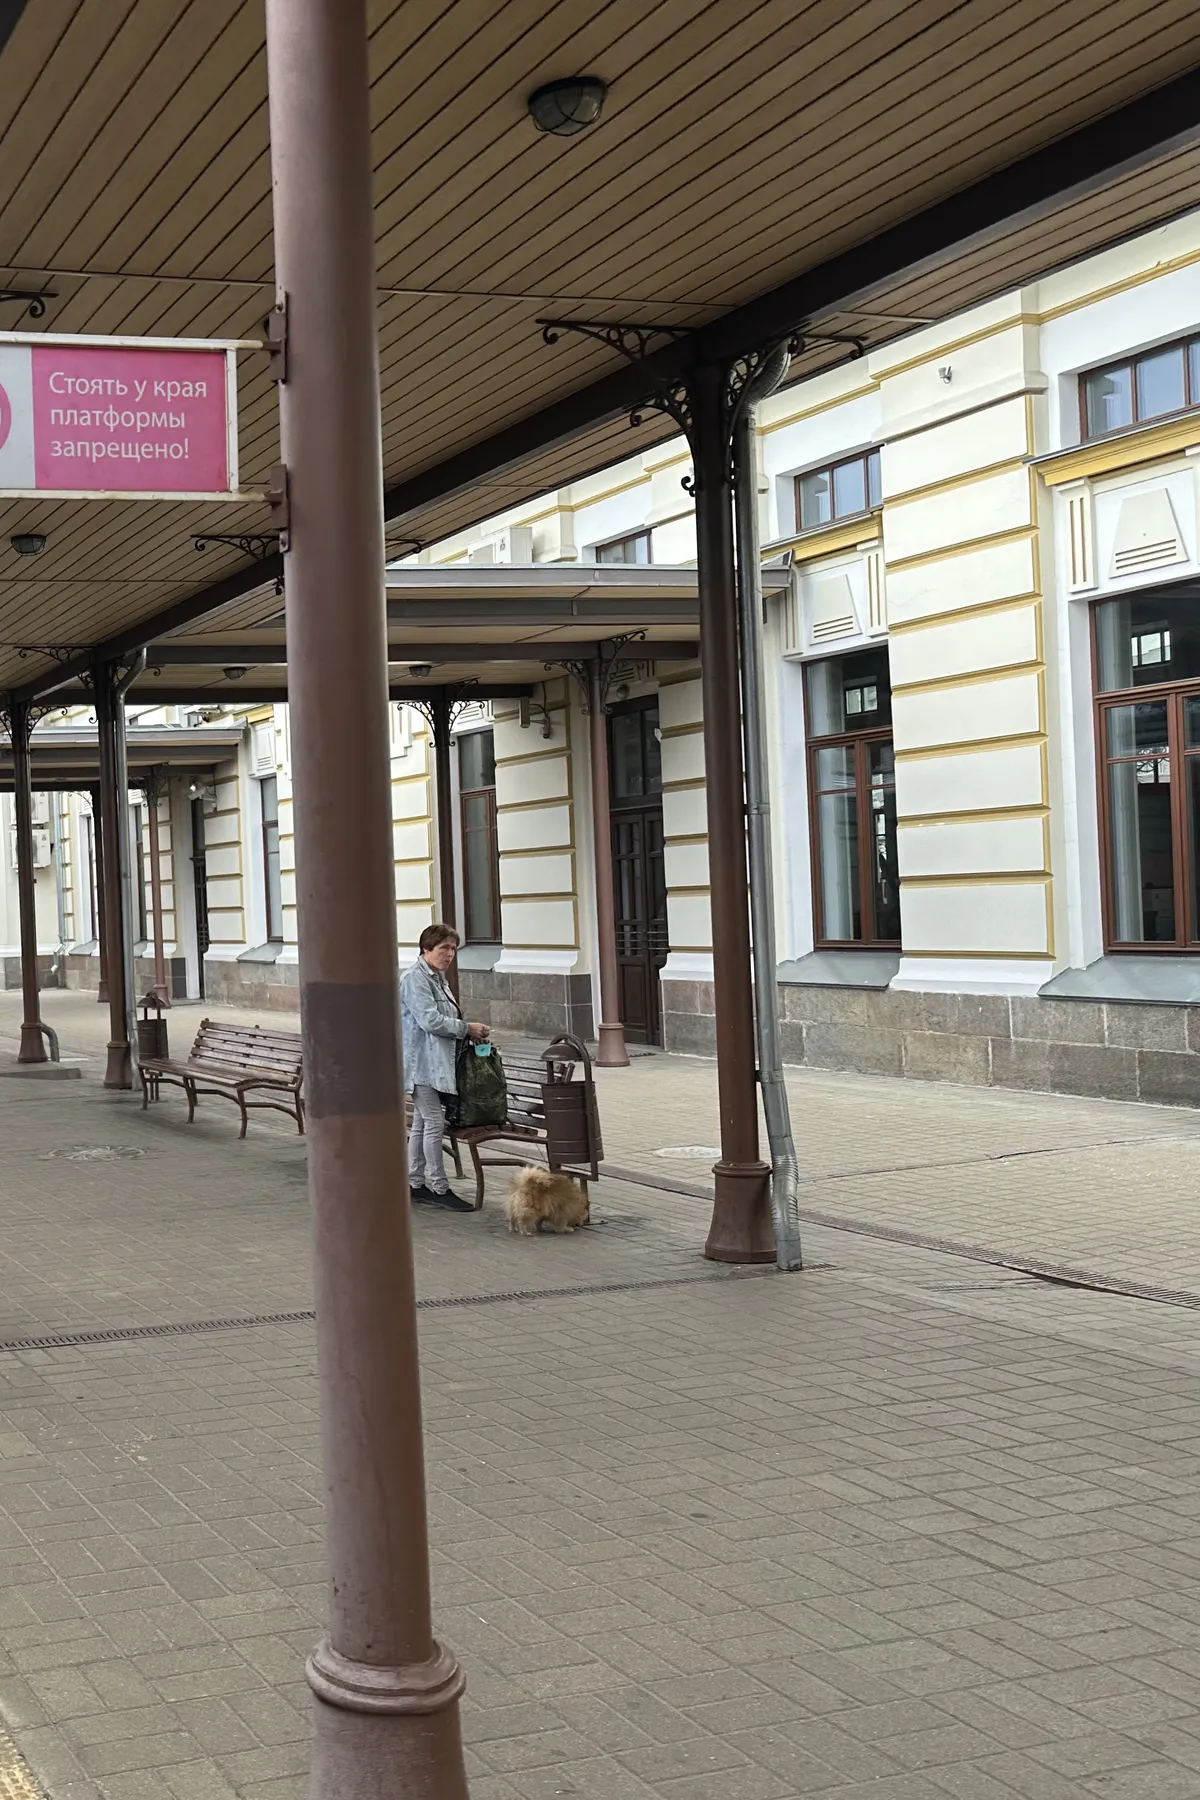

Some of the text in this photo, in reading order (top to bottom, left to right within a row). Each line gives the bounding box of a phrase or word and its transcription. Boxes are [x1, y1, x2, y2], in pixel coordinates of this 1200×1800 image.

[49, 371, 207, 402] Стоять у края
[50, 404, 185, 433] платформы
[50, 437, 189, 463] запрещено!
